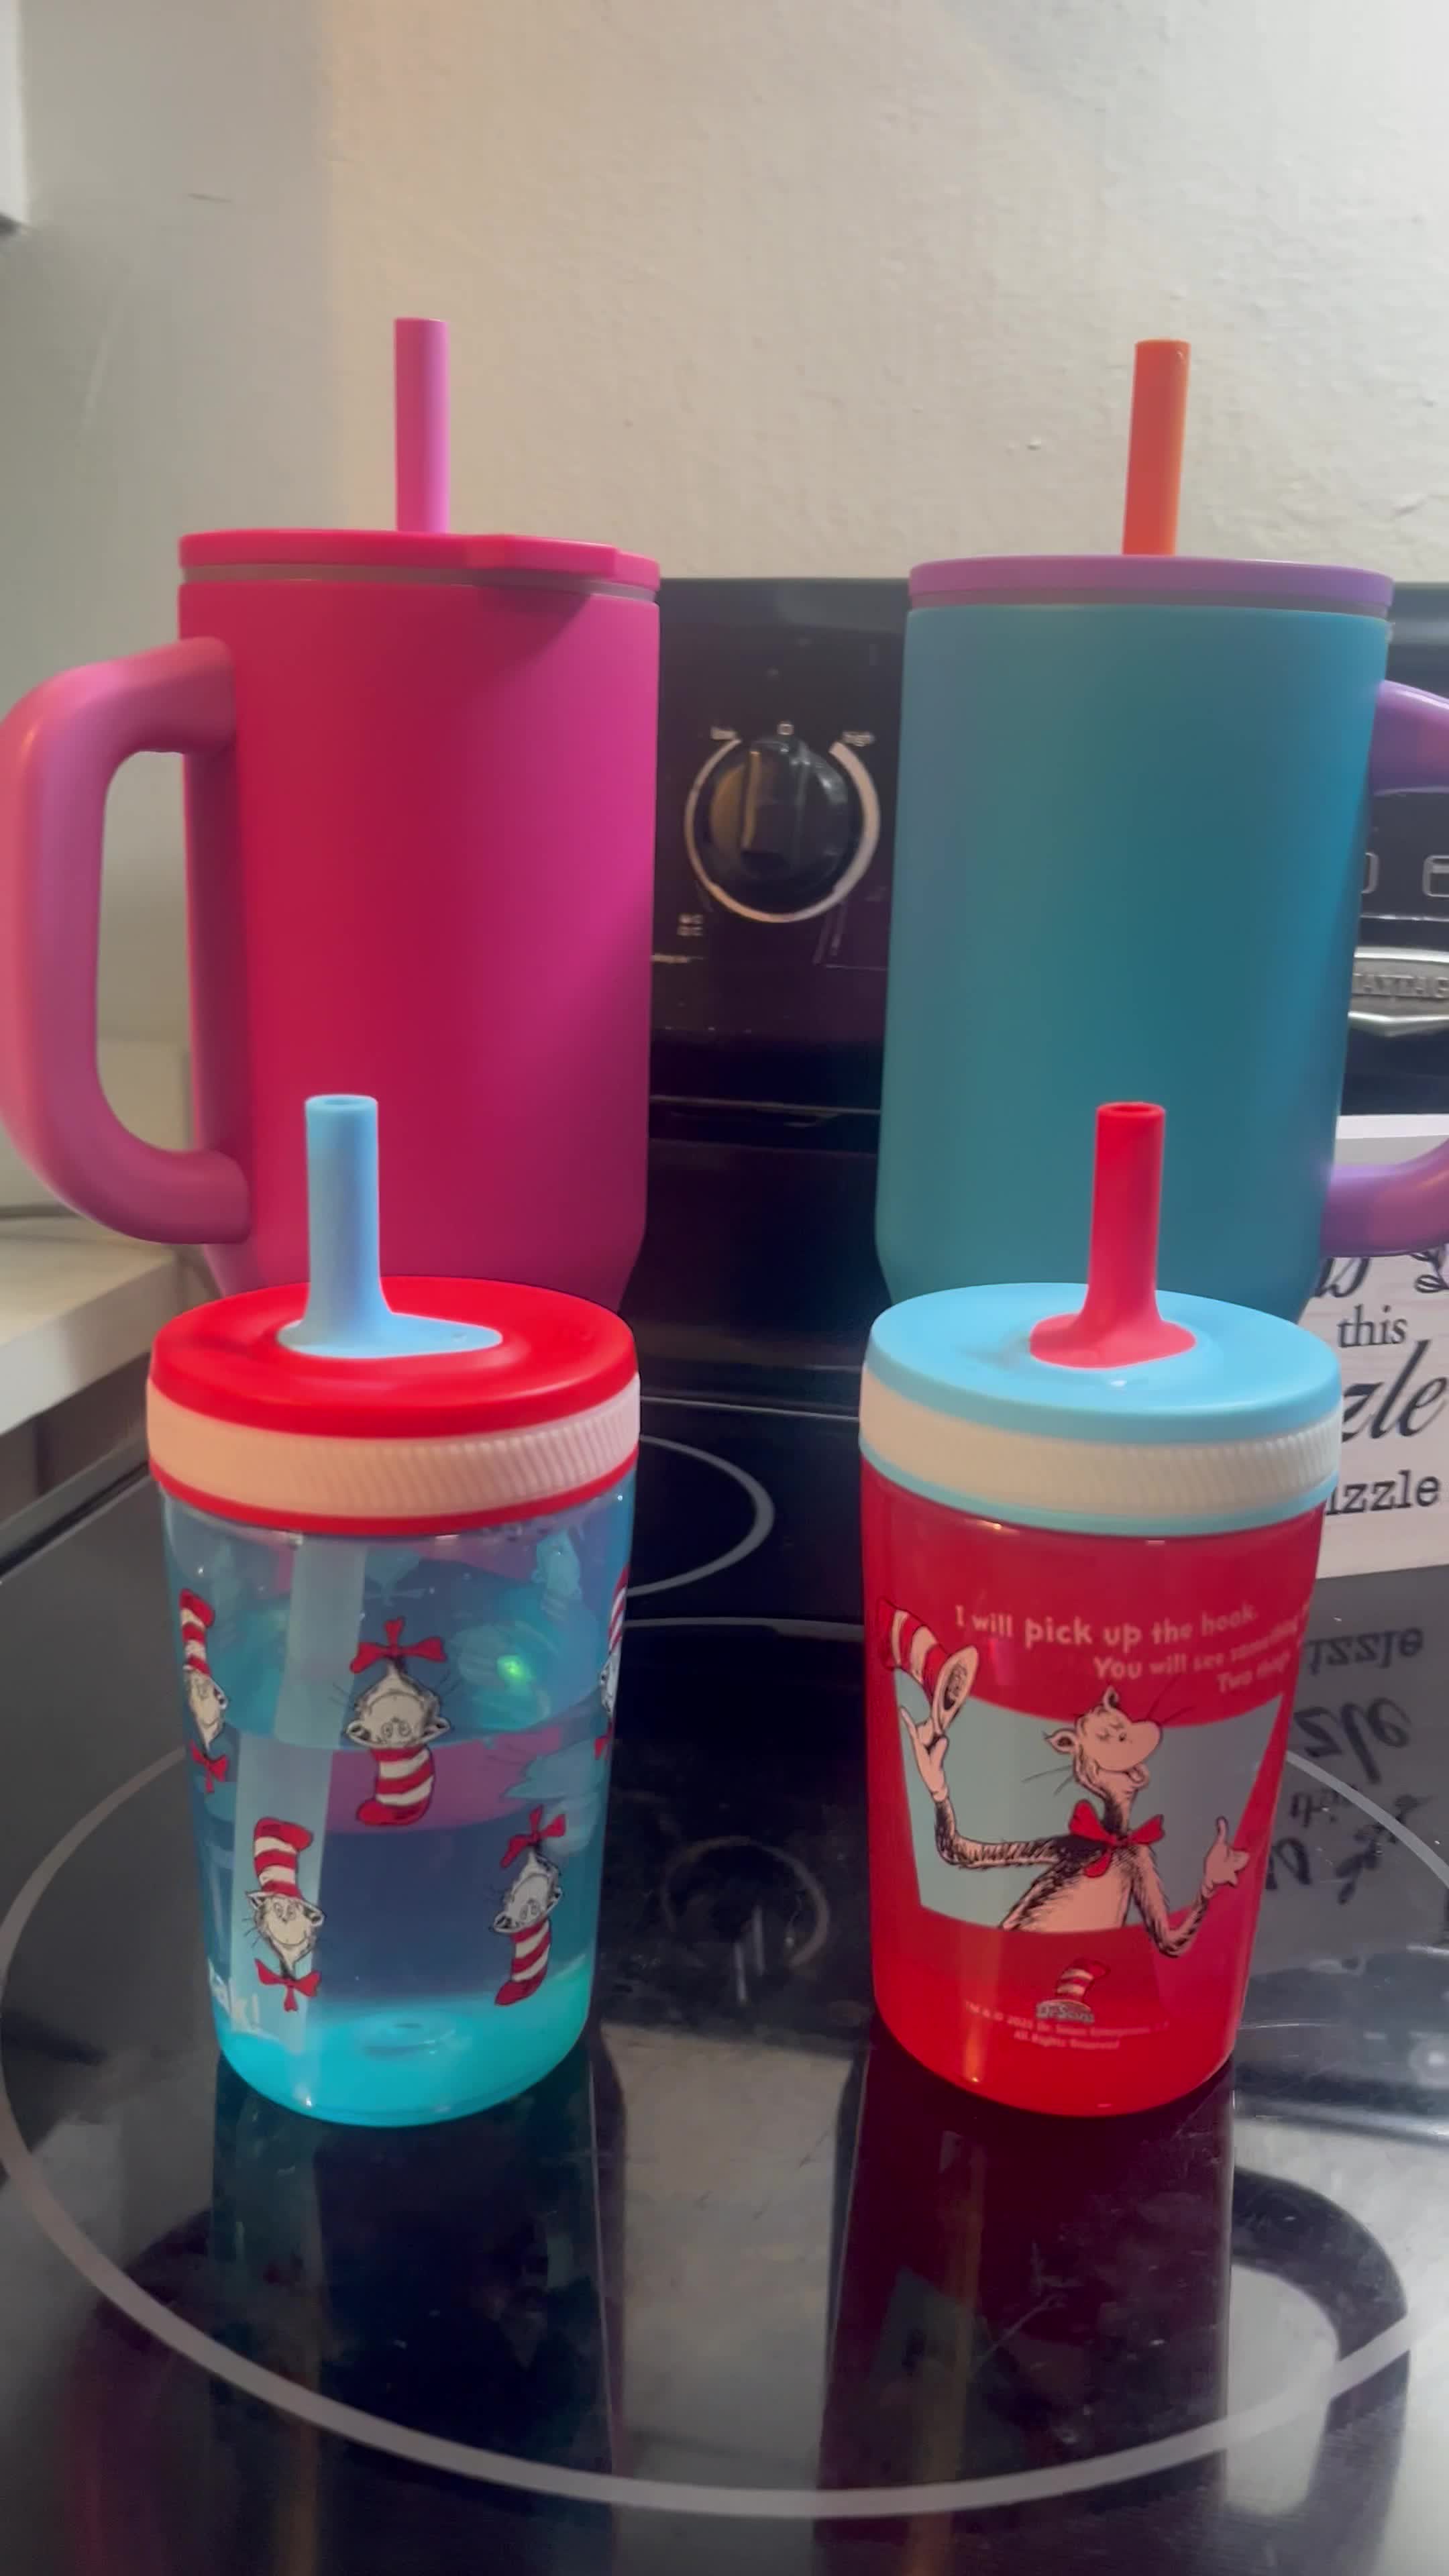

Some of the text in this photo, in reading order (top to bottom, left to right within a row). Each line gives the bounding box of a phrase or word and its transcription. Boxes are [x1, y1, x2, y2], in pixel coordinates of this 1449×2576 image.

[1337, 1303, 1407, 1348] this
[955, 1604, 965, 1627] I
[972, 1612, 1013, 1638] will
[1024, 1615, 1093, 1651] pick
[1103, 1622, 1142, 1654] up
[1151, 1617, 1193, 1644] the
[1093, 1654, 1142, 1680] You
[1149, 1652, 1188, 1675] will
